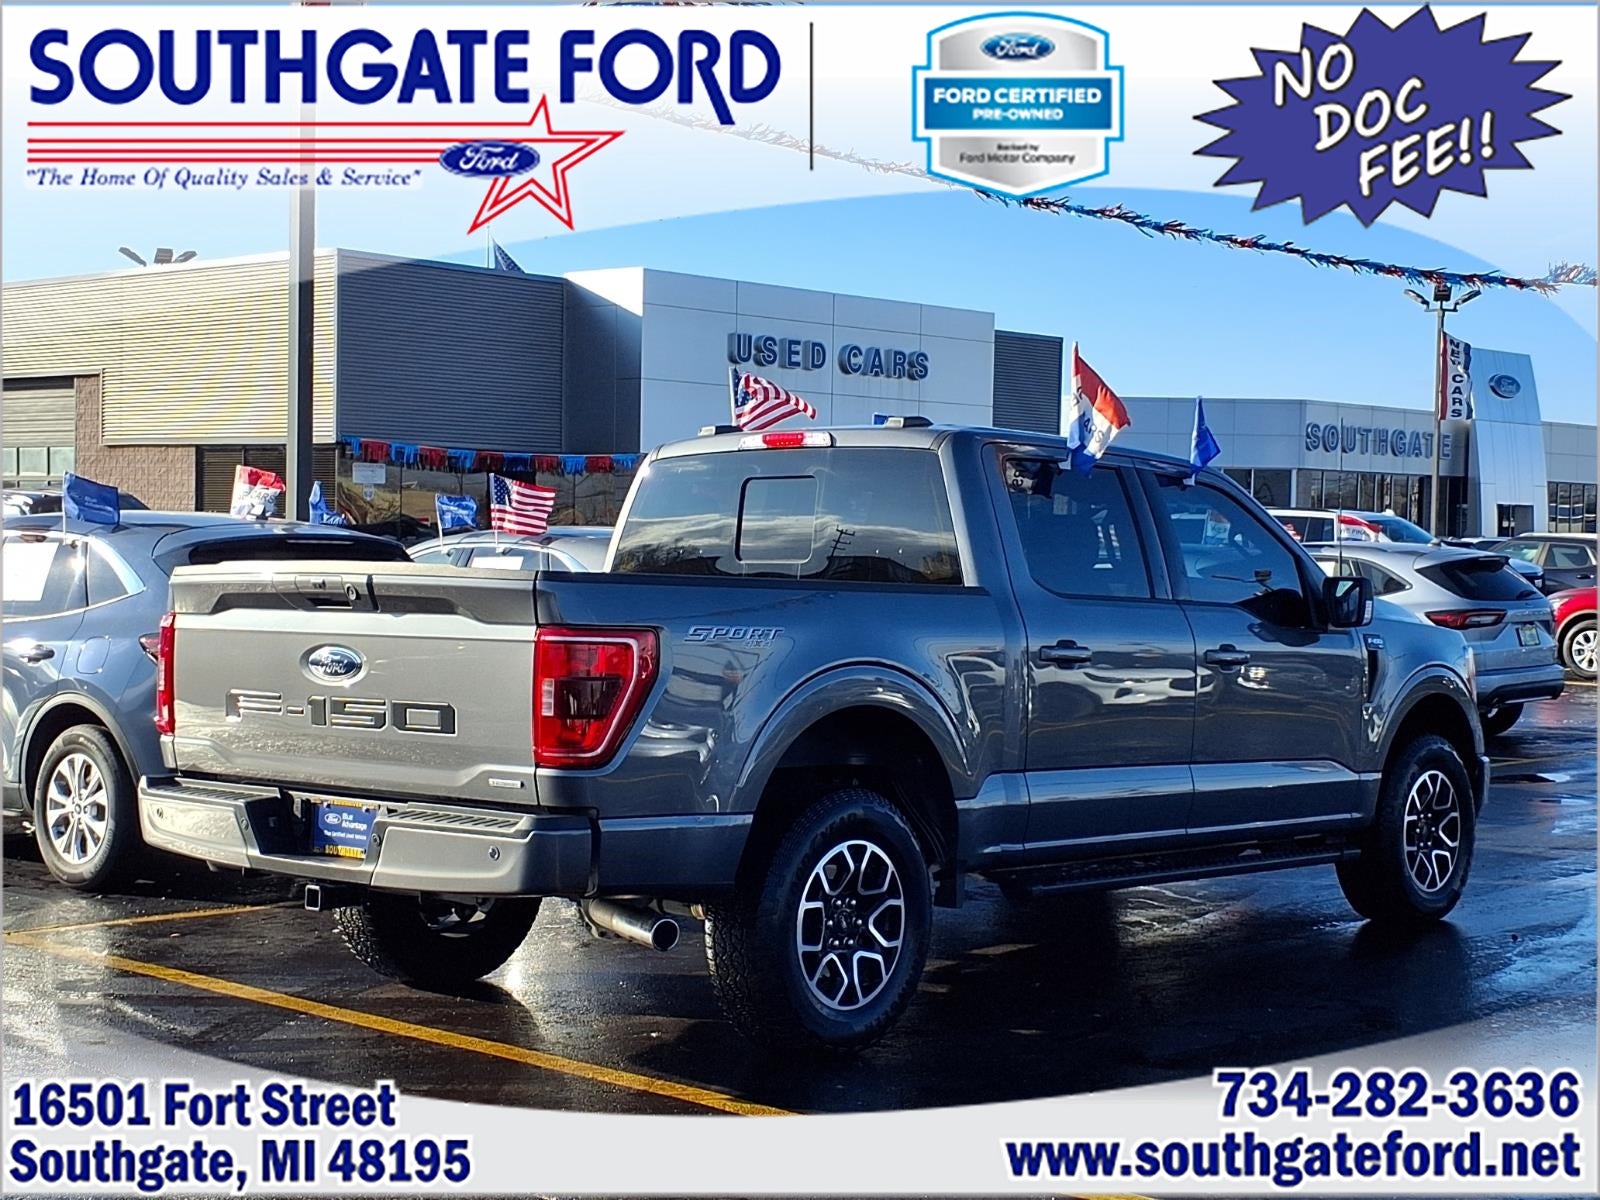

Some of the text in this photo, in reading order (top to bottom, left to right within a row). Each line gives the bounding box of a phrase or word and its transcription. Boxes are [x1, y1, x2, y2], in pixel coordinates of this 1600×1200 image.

[727, 333, 929, 380] USED CARS
[1450, 373, 1464, 418] CARS
[1305, 422, 1452, 459] SOUTHGATE
[684, 626, 784, 643] SPORT
[225, 688, 457, 736] F-150
